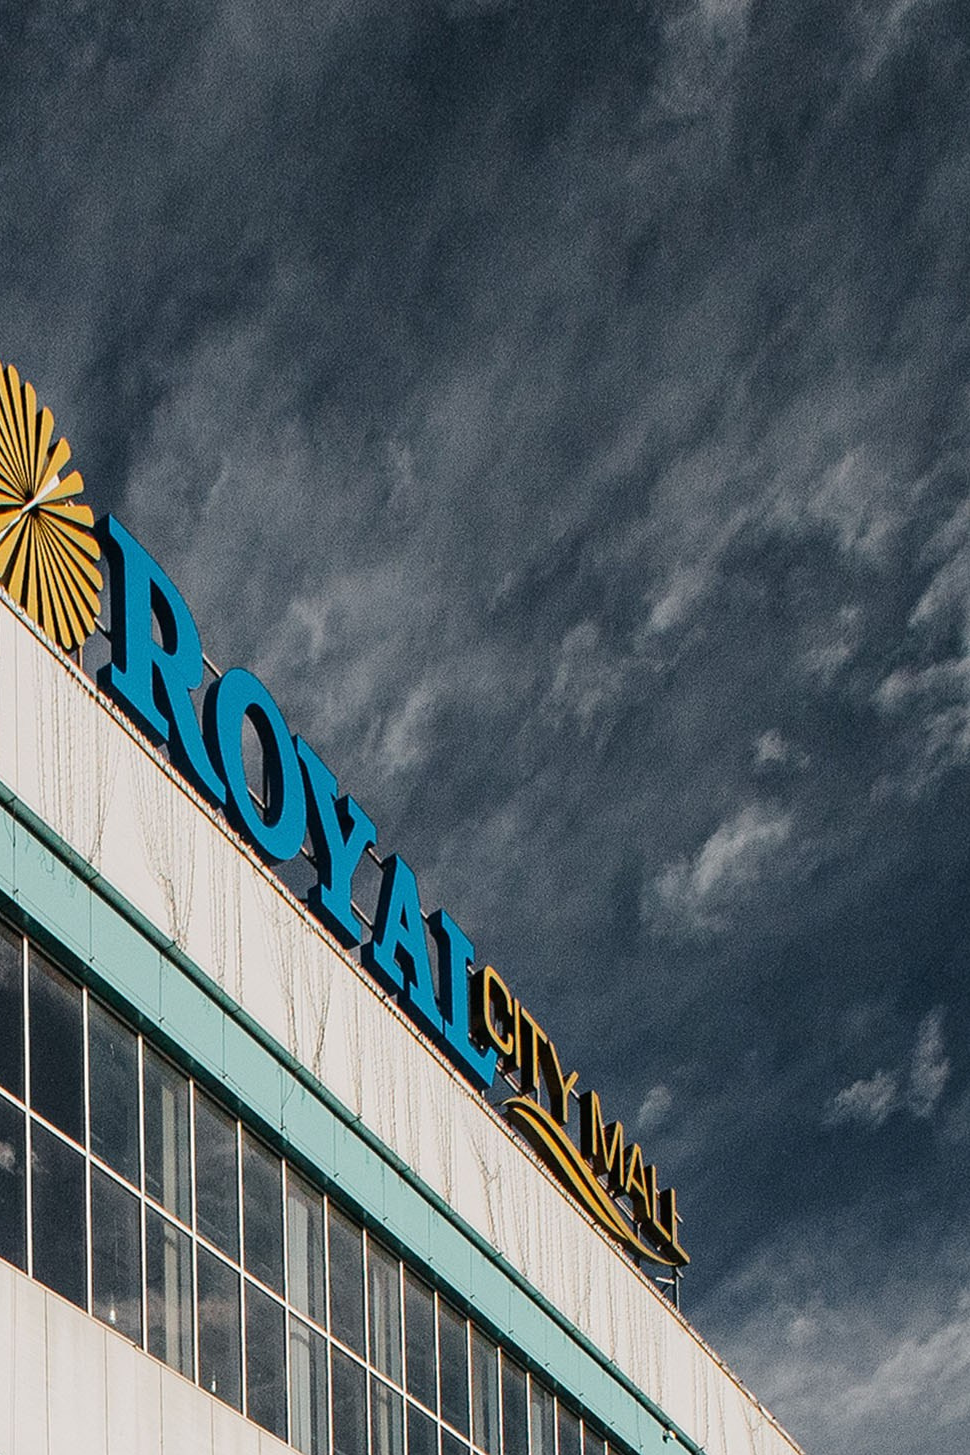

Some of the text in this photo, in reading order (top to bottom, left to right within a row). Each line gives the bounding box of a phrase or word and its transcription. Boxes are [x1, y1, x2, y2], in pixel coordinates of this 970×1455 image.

[107, 512, 497, 1088] ROYAL
[482, 964, 691, 1265] CITY MALL
